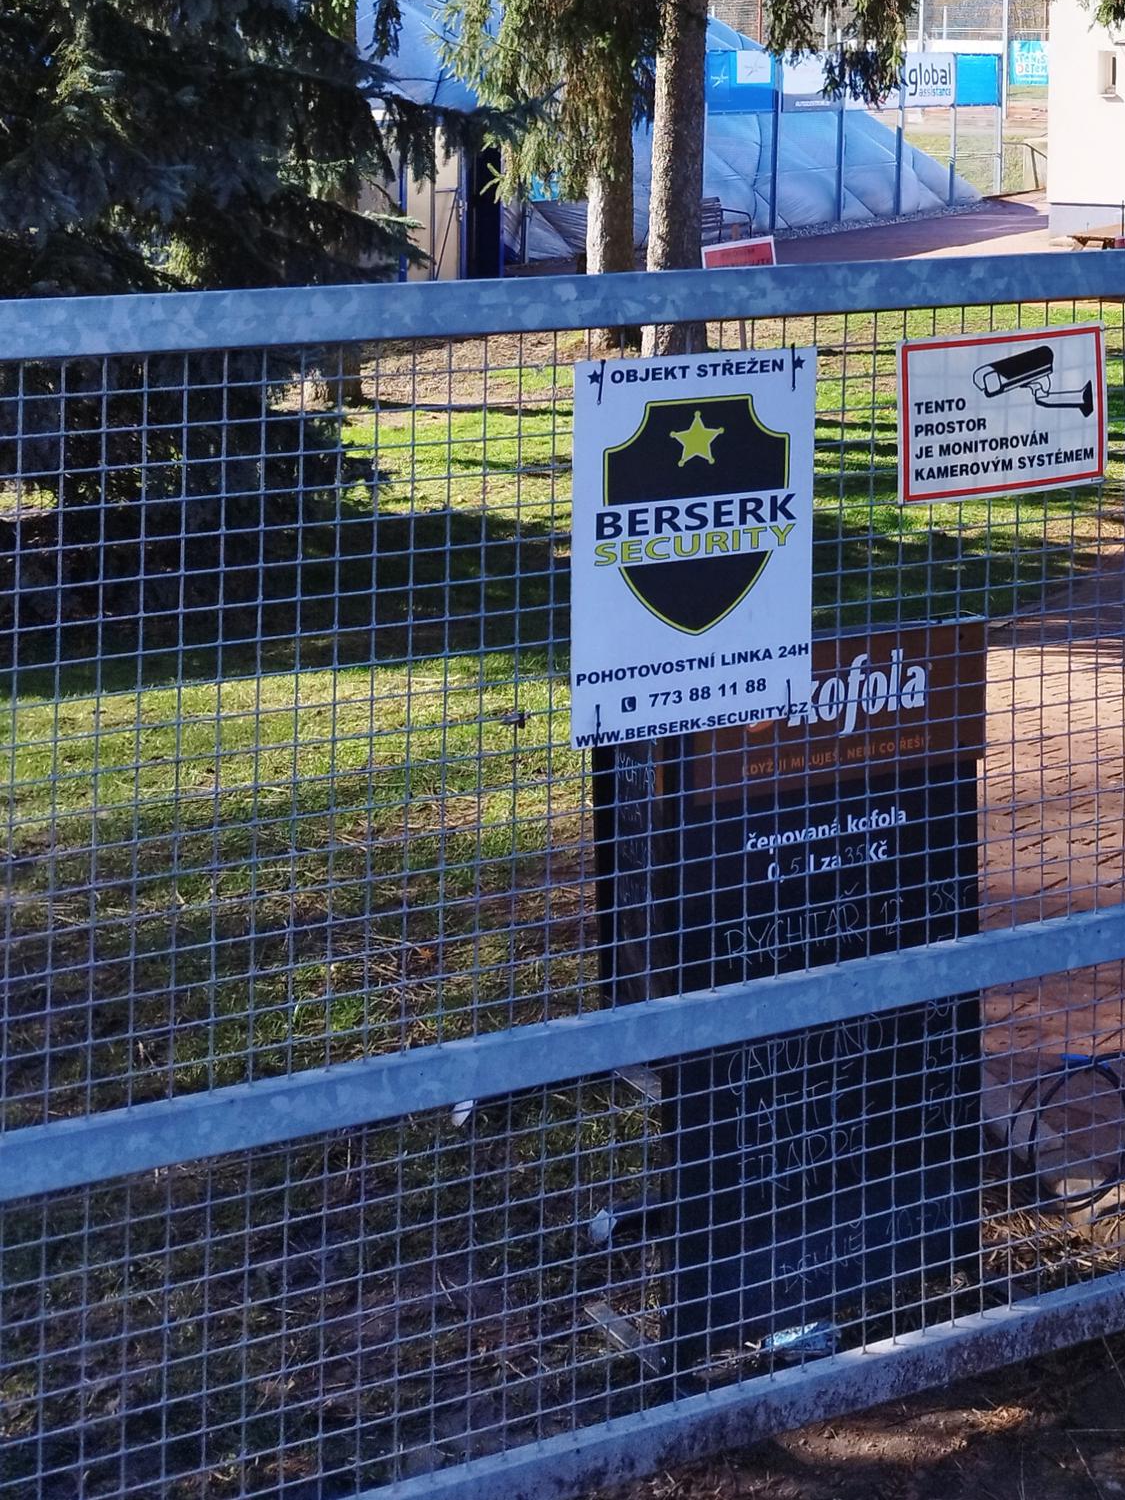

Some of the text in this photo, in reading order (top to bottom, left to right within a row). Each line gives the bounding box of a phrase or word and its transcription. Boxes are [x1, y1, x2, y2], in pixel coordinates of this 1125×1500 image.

[908, 62, 952, 97] global
[610, 358, 785, 384] OBJEKT STŘEŽEN
[914, 398, 966, 415] TENTO
[914, 418, 987, 438] PROSTOR
[915, 430, 1049, 460] JE MONITOROVÁN
[914, 447, 1095, 482] KAMEROVÝM SYSTÉMEM
[596, 493, 797, 541] BERSERK
[594, 523, 795, 568] SECURITY
[576, 643, 809, 687] POHOTOVOSTNÍ LINKA 24H
[648, 678, 767, 708] 773 88 11 88
[575, 701, 809, 748] WWW.BERSERK-SECURITY.CZ
[879, 741, 895, 754] CO
[746, 806, 907, 854] čepovaná kofola
[820, 854, 842, 871] za
[867, 839, 888, 862] Kč
